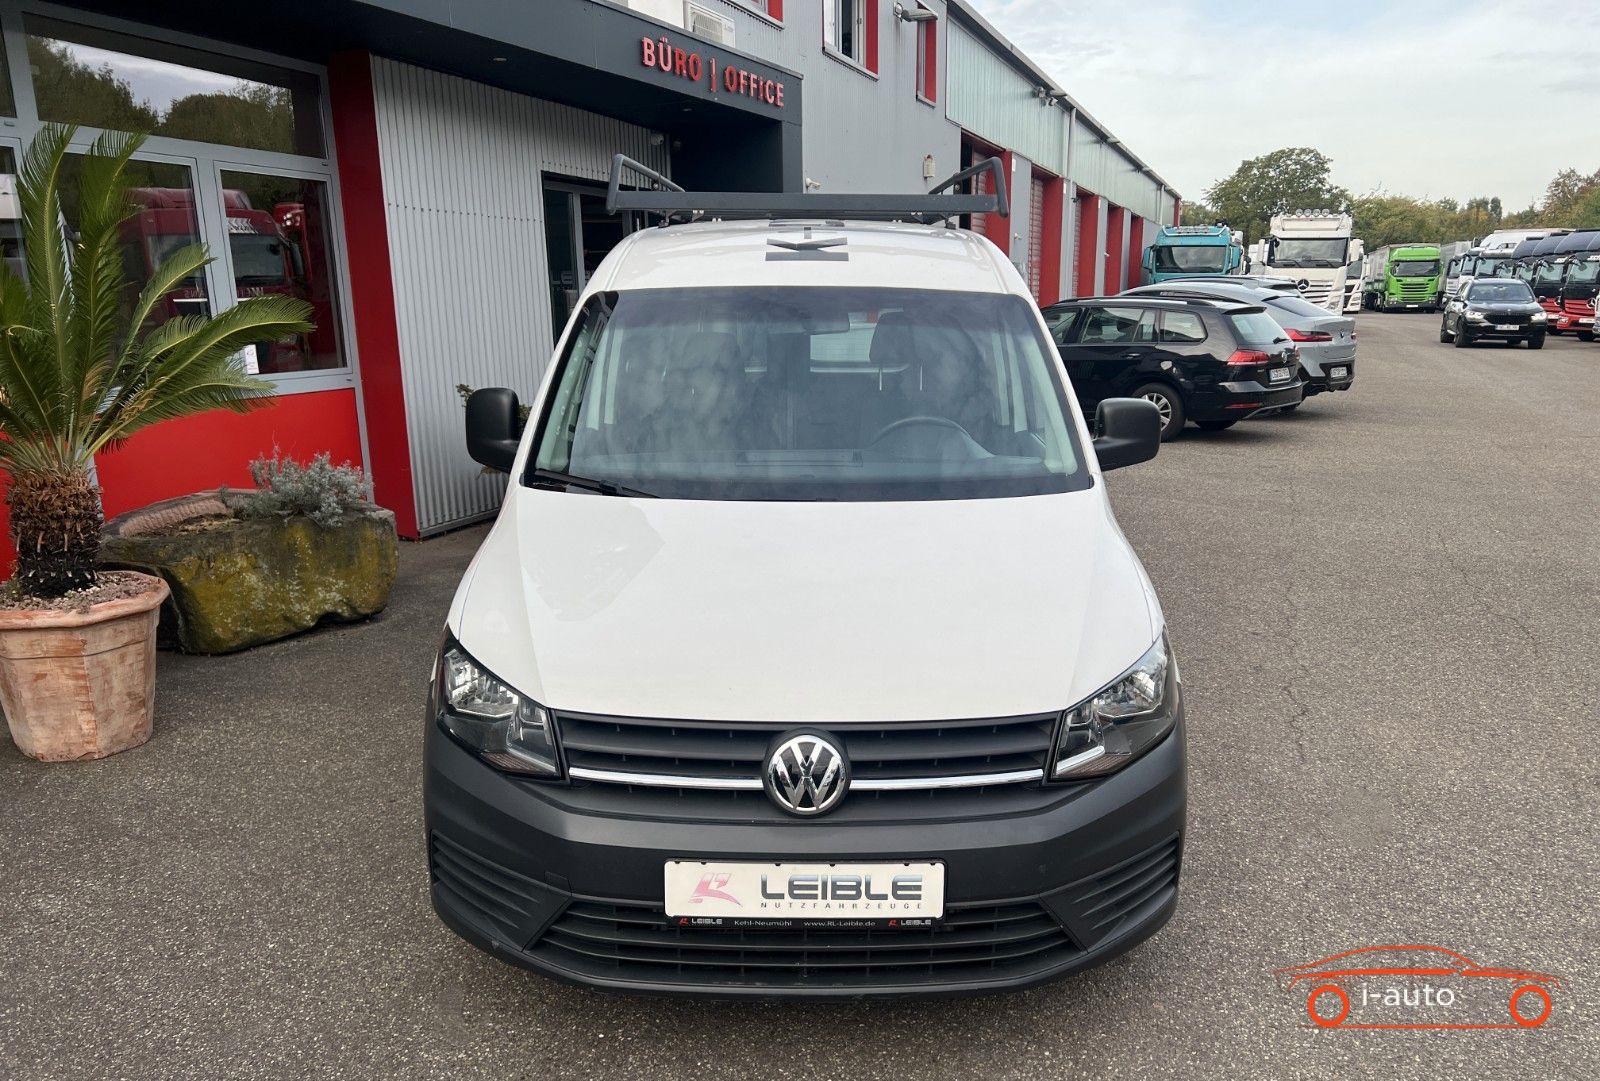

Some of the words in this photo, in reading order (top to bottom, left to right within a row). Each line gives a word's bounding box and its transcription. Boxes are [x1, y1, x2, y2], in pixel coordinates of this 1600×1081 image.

[641, 36, 702, 82] BÜRO
[760, 874, 923, 901] LEIBLE
[760, 902, 922, 910] NUTZFAHRZEUGE
[734, 919, 792, 927] Kehl-Neumühl
[803, 919, 876, 927] www.RL-Leible.de
[900, 918, 932, 926] LEIBLE
